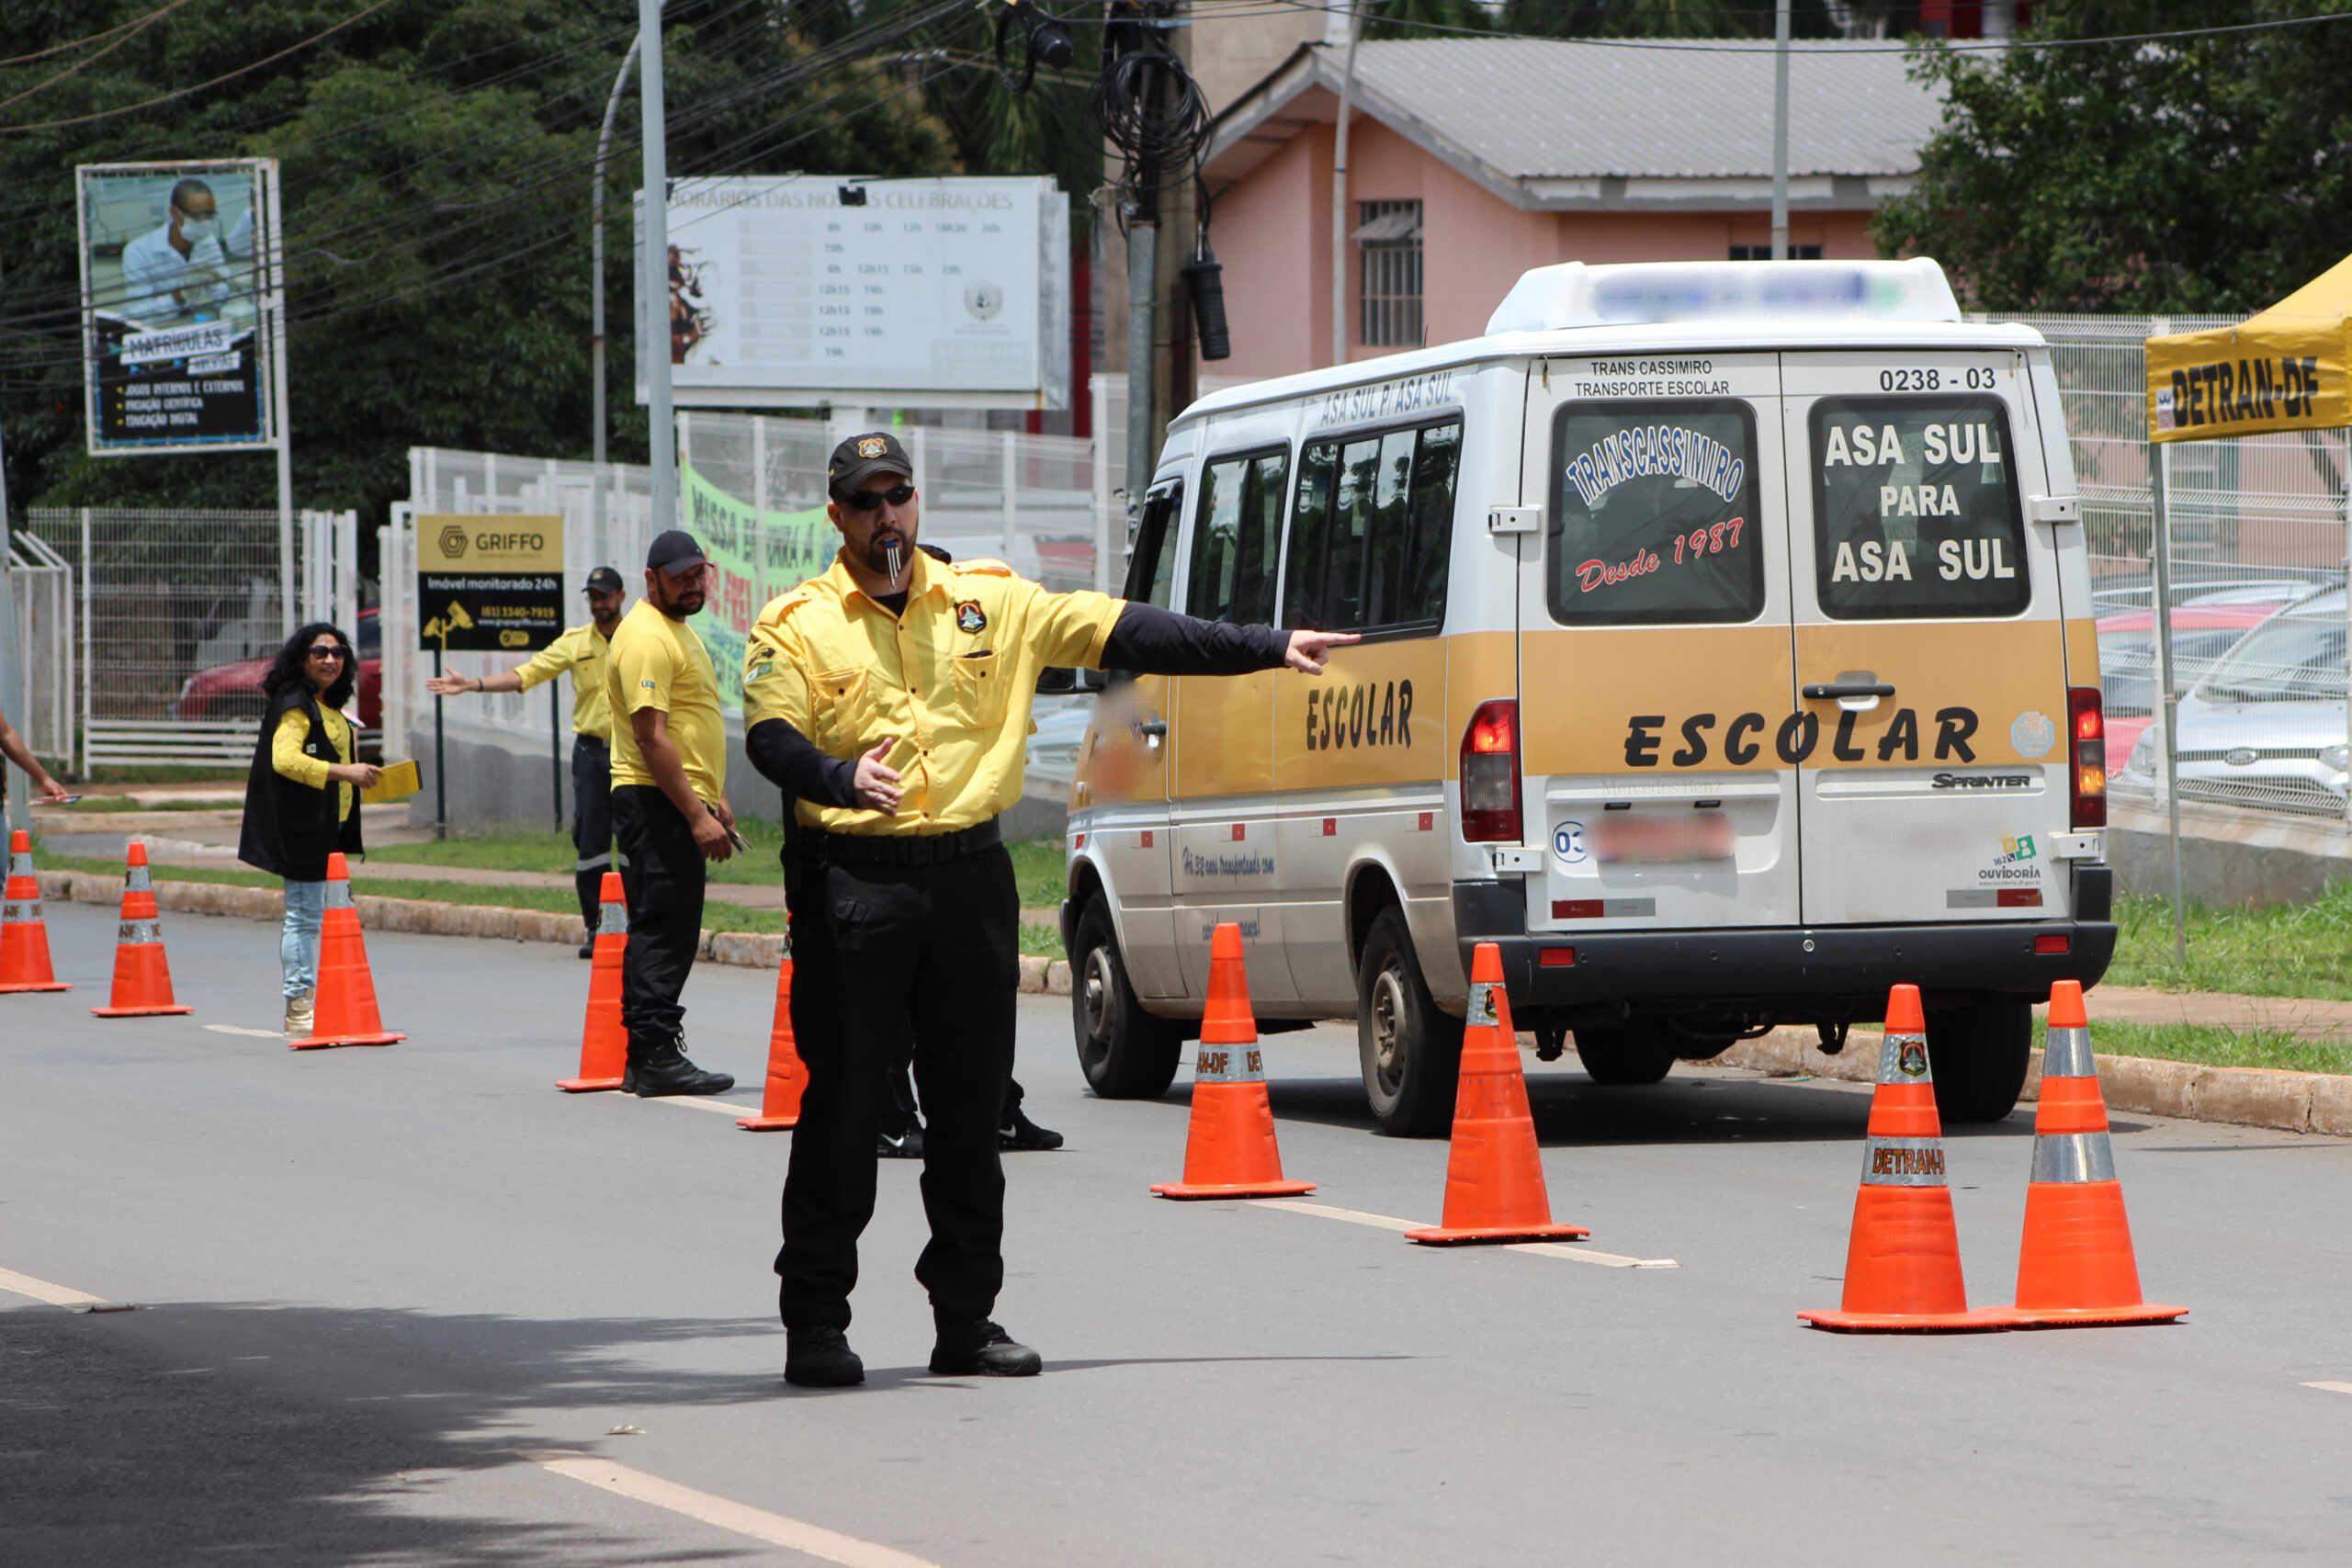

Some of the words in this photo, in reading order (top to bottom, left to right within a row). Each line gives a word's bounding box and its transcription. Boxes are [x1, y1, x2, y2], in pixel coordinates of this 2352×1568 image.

[766, 190, 802, 208] DAS
[1590, 361, 1635, 376] TRANS
[1639, 360, 1712, 375] CASSIMIRO
[1880, 369, 1940, 391] 0238
[1966, 367, 1996, 389] 03
[194, 380, 200, 394] E
[203, 379, 244, 393] EXTERNOS
[1320, 392, 1348, 426] ASA
[1351, 387, 1375, 420] SUL
[1395, 378, 1422, 412] ASA
[1427, 370, 1452, 406] SUL
[1575, 381, 1664, 396] TRANSPORTE
[1668, 380, 1730, 395] ESCOLAR
[2171, 356, 2318, 427] DETRAN-DF
[169, 412, 198, 425] DIGITAL
[1825, 425, 1905, 467] ASA
[1924, 423, 2000, 465] SUL
[1566, 425, 1744, 506] TRANSCASSIMIRO
[1880, 485, 1961, 517] PARA
[476, 533, 544, 550] GRIFFO
[1576, 548, 1660, 592] Desde
[1674, 517, 1743, 564] 1987
[1831, 540, 1912, 582] ASA
[1939, 538, 2015, 581] SUL
[428, 577, 466, 589] Imóvel
[468, 577, 533, 590] monitorado
[535, 577, 558, 590] 24h
[1306, 679, 1413, 750] ESCOLAR
[1624, 707, 1979, 766] ESCOLAR
[1195, 855, 1204, 876] 32
[1993, 855, 2007, 865] 162
[1872, 1148, 1946, 1176] DETRAN-D
